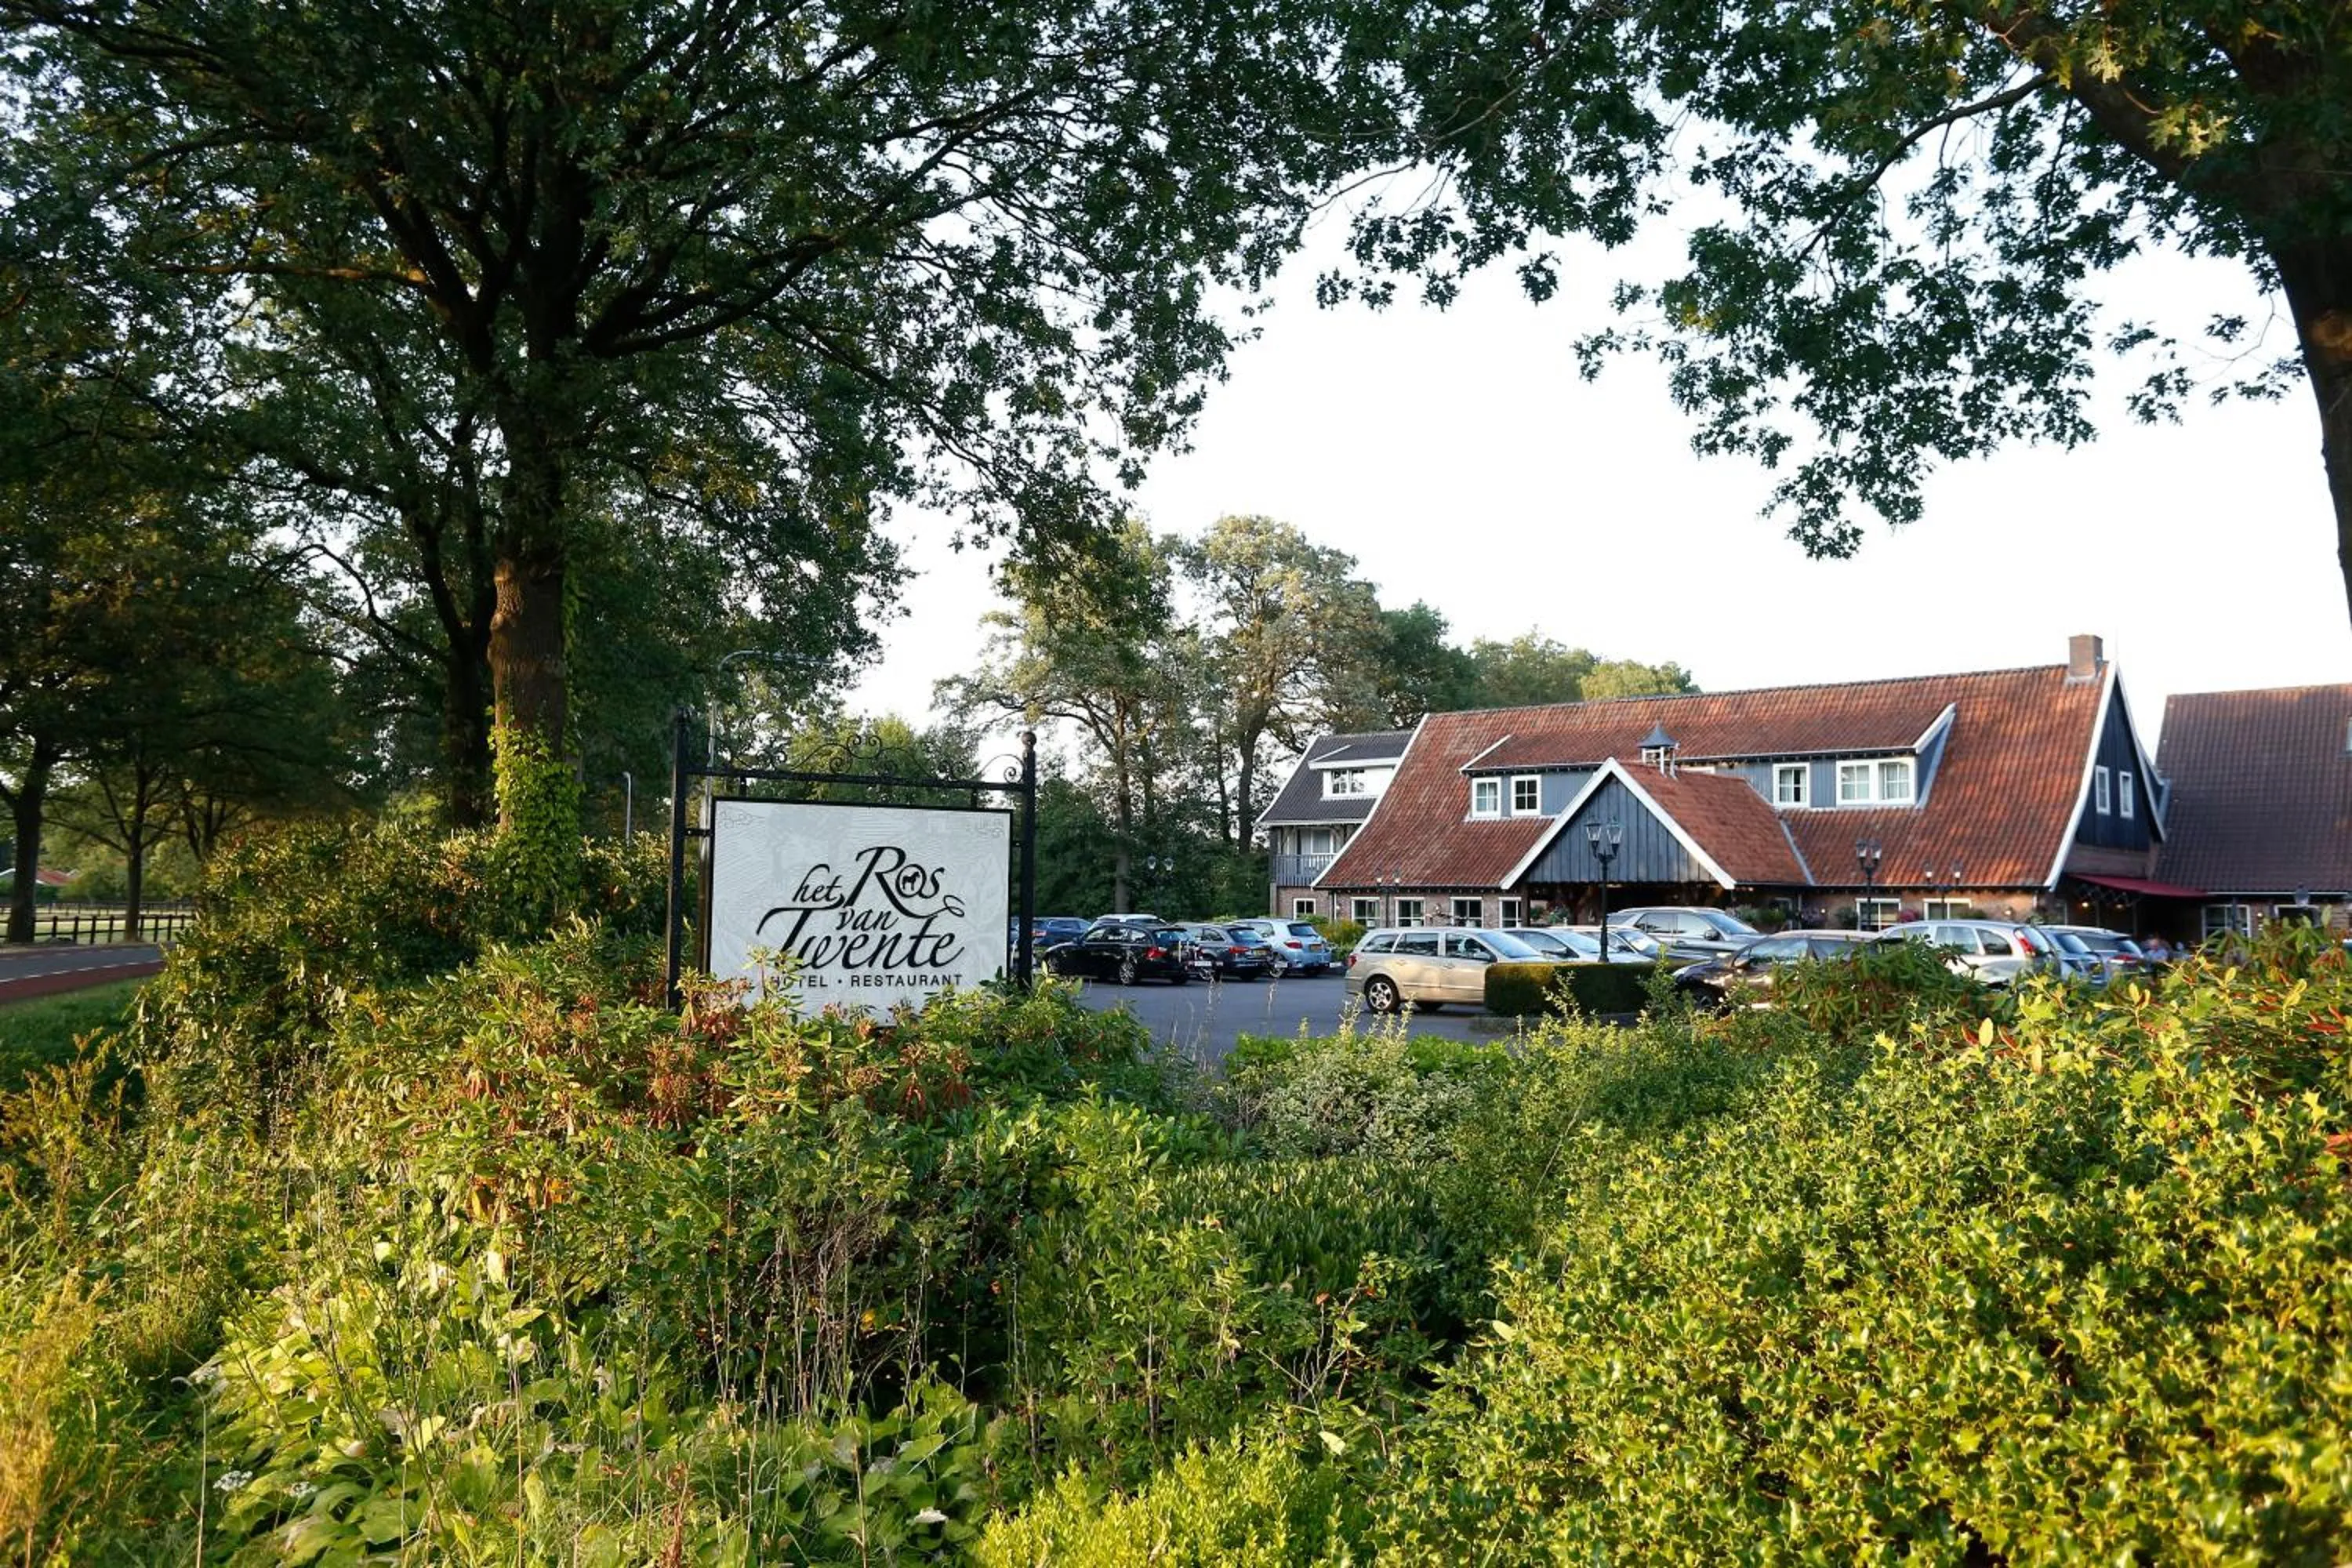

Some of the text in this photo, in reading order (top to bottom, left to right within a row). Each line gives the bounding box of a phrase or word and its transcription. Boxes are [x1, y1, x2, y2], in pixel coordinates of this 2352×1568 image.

[792, 846, 965, 919] het Ros
[756, 903, 965, 970] Twente
[836, 909, 898, 931] van
[851, 975, 963, 987] RESTAURANT
